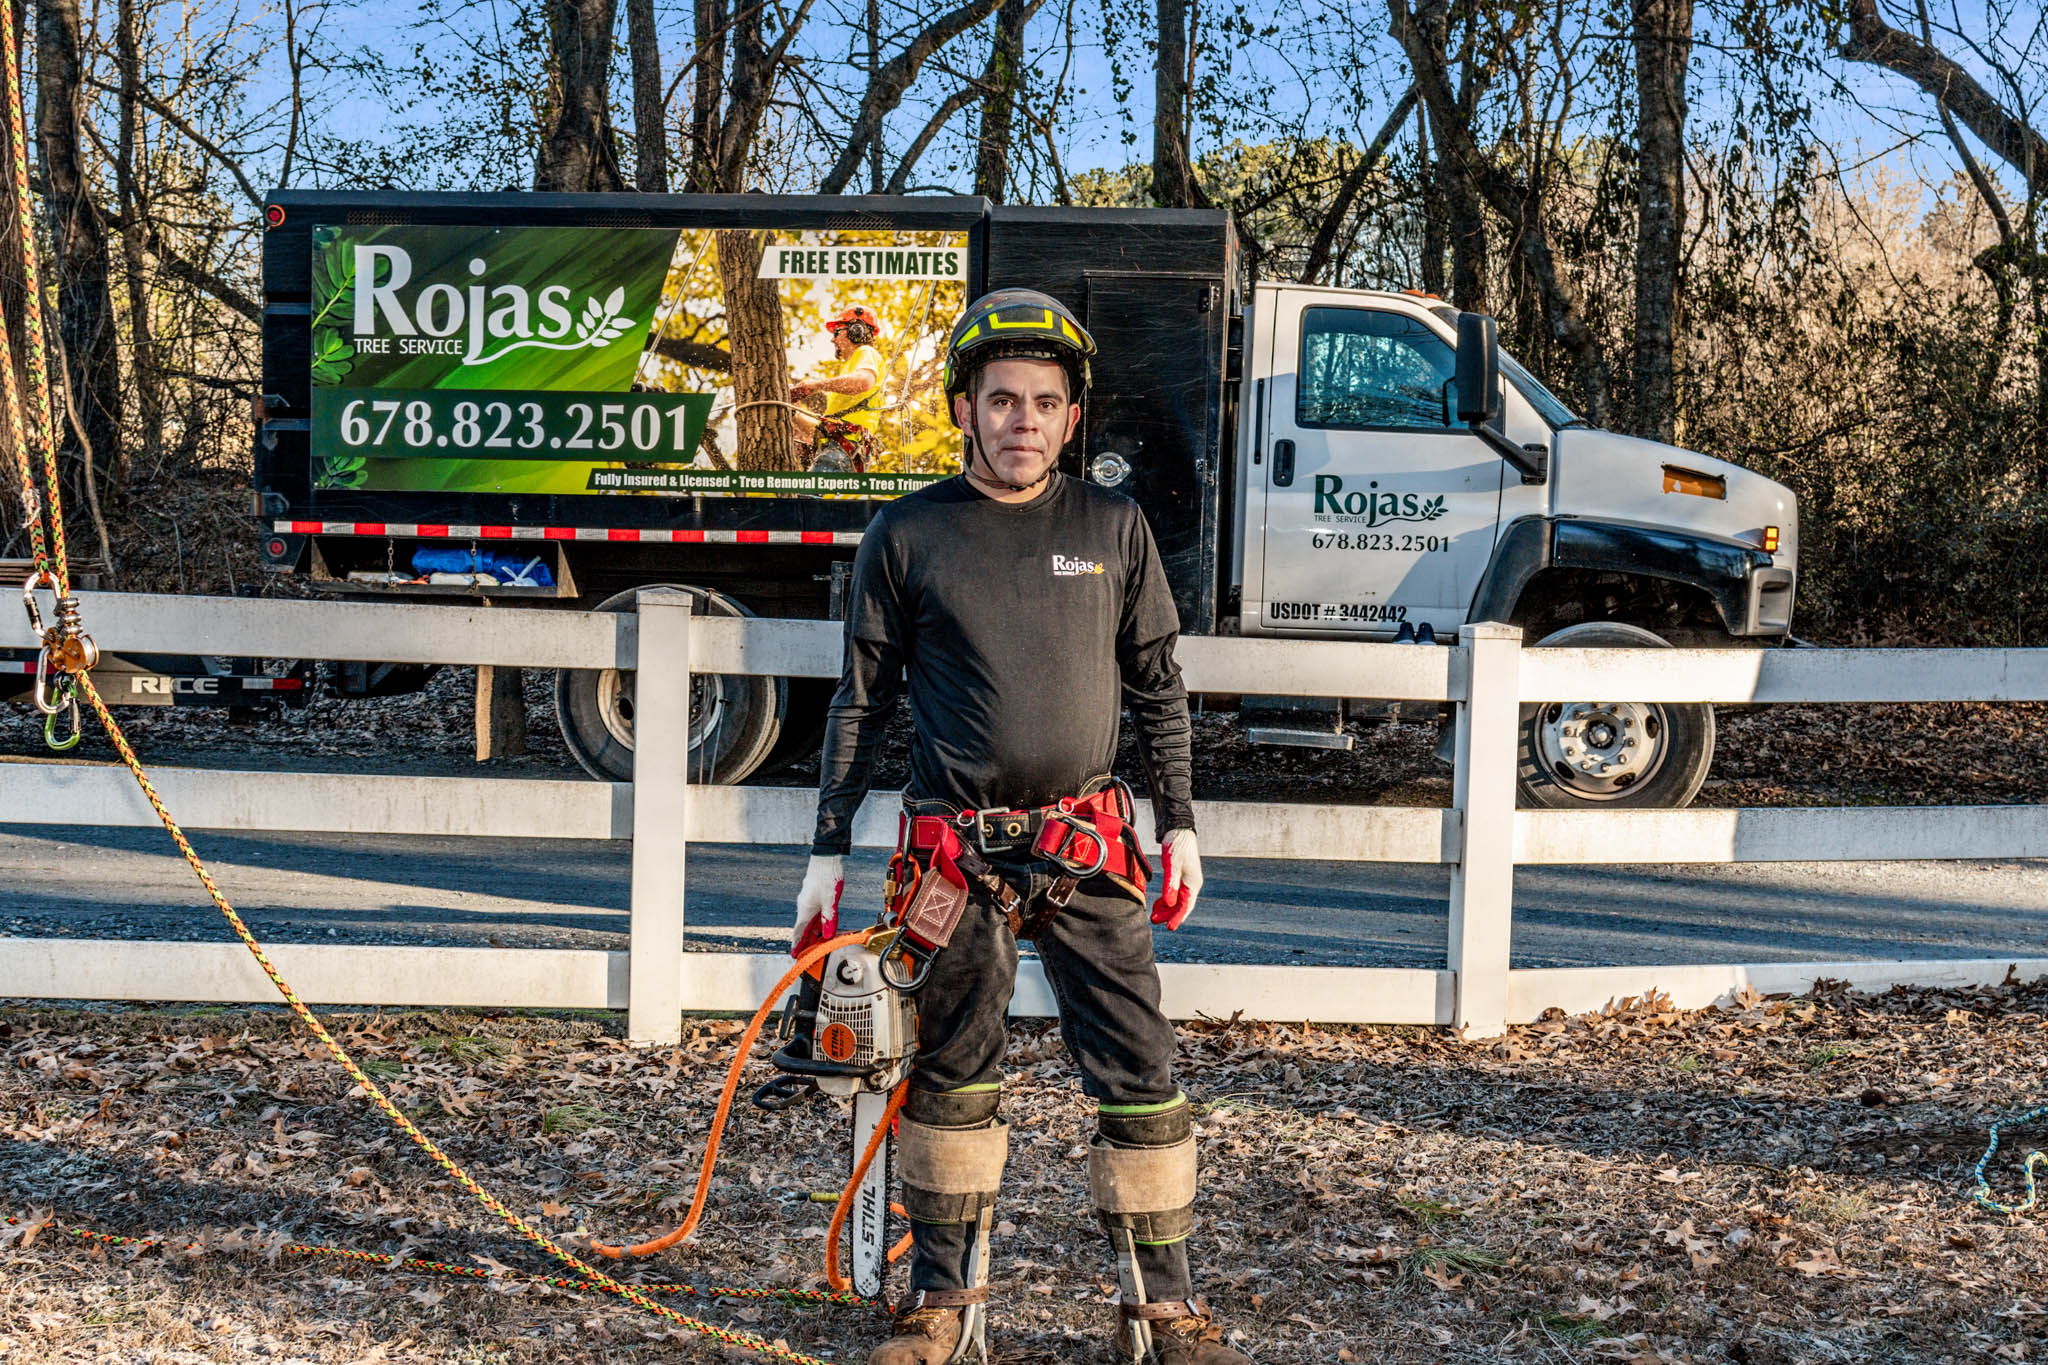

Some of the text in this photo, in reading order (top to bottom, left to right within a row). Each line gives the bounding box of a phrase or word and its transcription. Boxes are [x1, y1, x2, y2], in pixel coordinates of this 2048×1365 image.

[779, 250, 958, 275] FREE ESTIMATES
[353, 245, 572, 365] Rojas
[354, 339, 463, 355] TREE SERVICE
[340, 400, 685, 451] 678.823.2501
[595, 473, 937, 491] Fully Insured & Licensed Tree Removal Experts Tree Trim
[1314, 474, 1419, 527] Rojas
[1335, 515, 1367, 524] SERVICE
[1312, 533, 1449, 552] 678.823.2501
[1052, 555, 1094, 575] Rojas
[1270, 602, 1320, 620] USDOT
[1340, 604, 1407, 622] 3442442
[131, 676, 219, 694] RICE
[862, 1186, 875, 1246] STIHL
